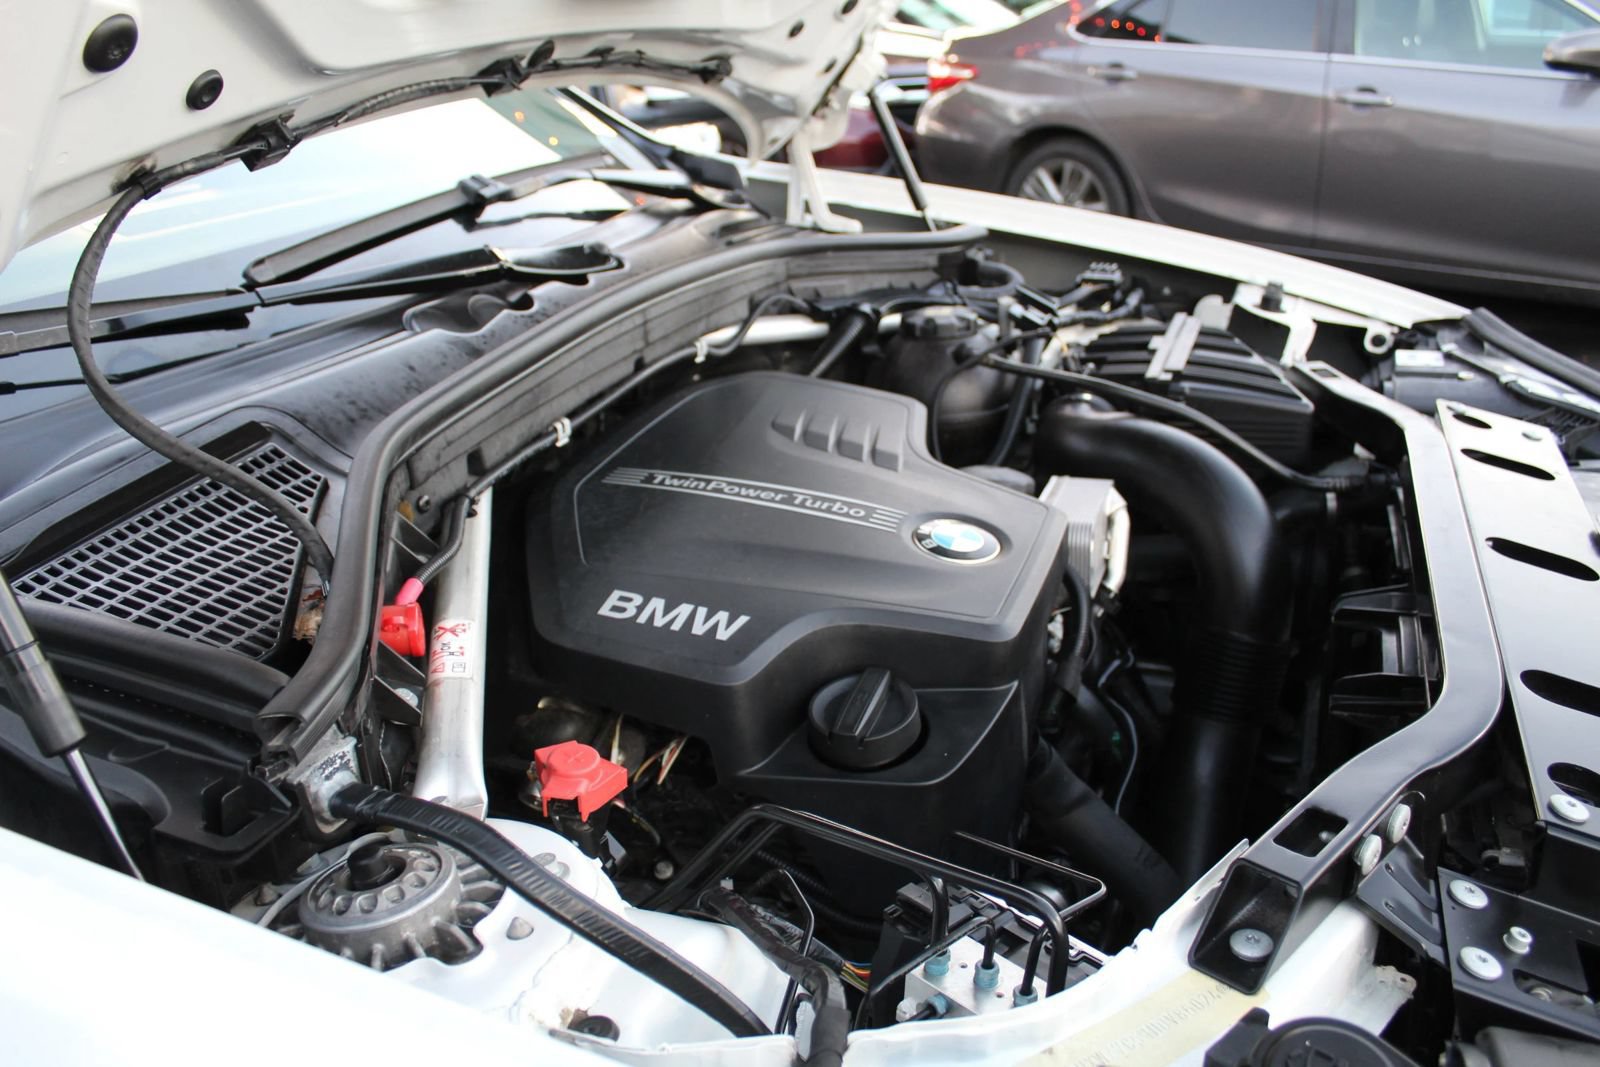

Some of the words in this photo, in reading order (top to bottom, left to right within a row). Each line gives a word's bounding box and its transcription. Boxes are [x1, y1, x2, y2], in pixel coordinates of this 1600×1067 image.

[652, 473, 787, 503] TwinPower
[792, 492, 866, 518] Turbo
[597, 589, 751, 641] BMW
